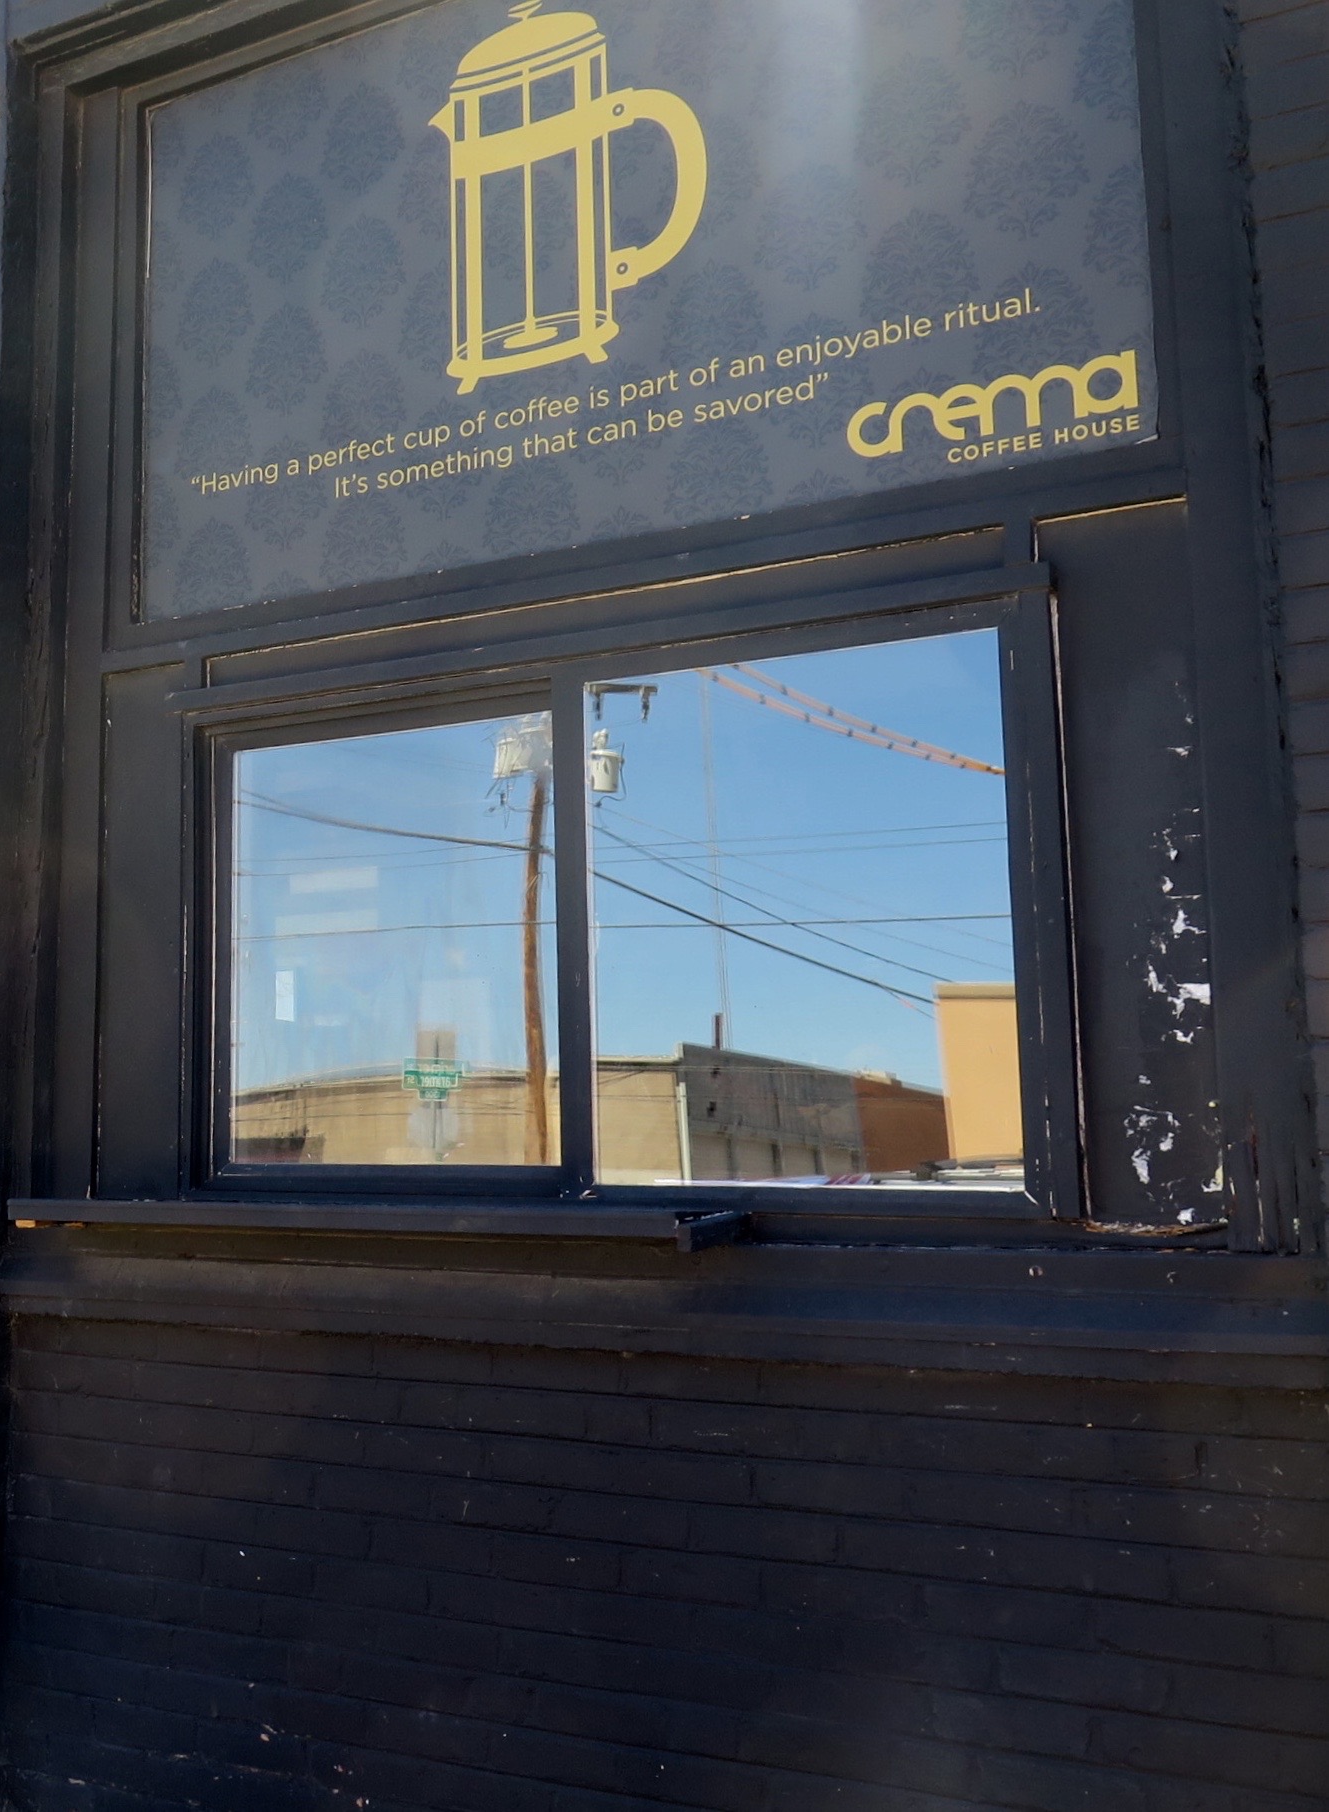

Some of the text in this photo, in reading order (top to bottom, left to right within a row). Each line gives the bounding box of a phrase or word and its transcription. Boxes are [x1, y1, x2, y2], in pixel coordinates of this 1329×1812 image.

[286, 459, 301, 476] a
[307, 435, 396, 474] perfect
[403, 424, 451, 449] cup
[459, 410, 487, 437] of
[494, 396, 581, 429] coffee
[589, 387, 611, 408] is
[620, 370, 680, 405] part
[689, 358, 720, 387] of
[729, 353, 766, 378] an
[776, 315, 933, 368] enjoyable
[943, 287, 1041, 331] ritual.
[847, 349, 1140, 458] crema
[376, 446, 514, 489] something
[522, 428, 578, 459] that
[586, 419, 638, 445] can
[647, 408, 685, 432] be
[946, 413, 1141, 464] COFFEE HOUSE
